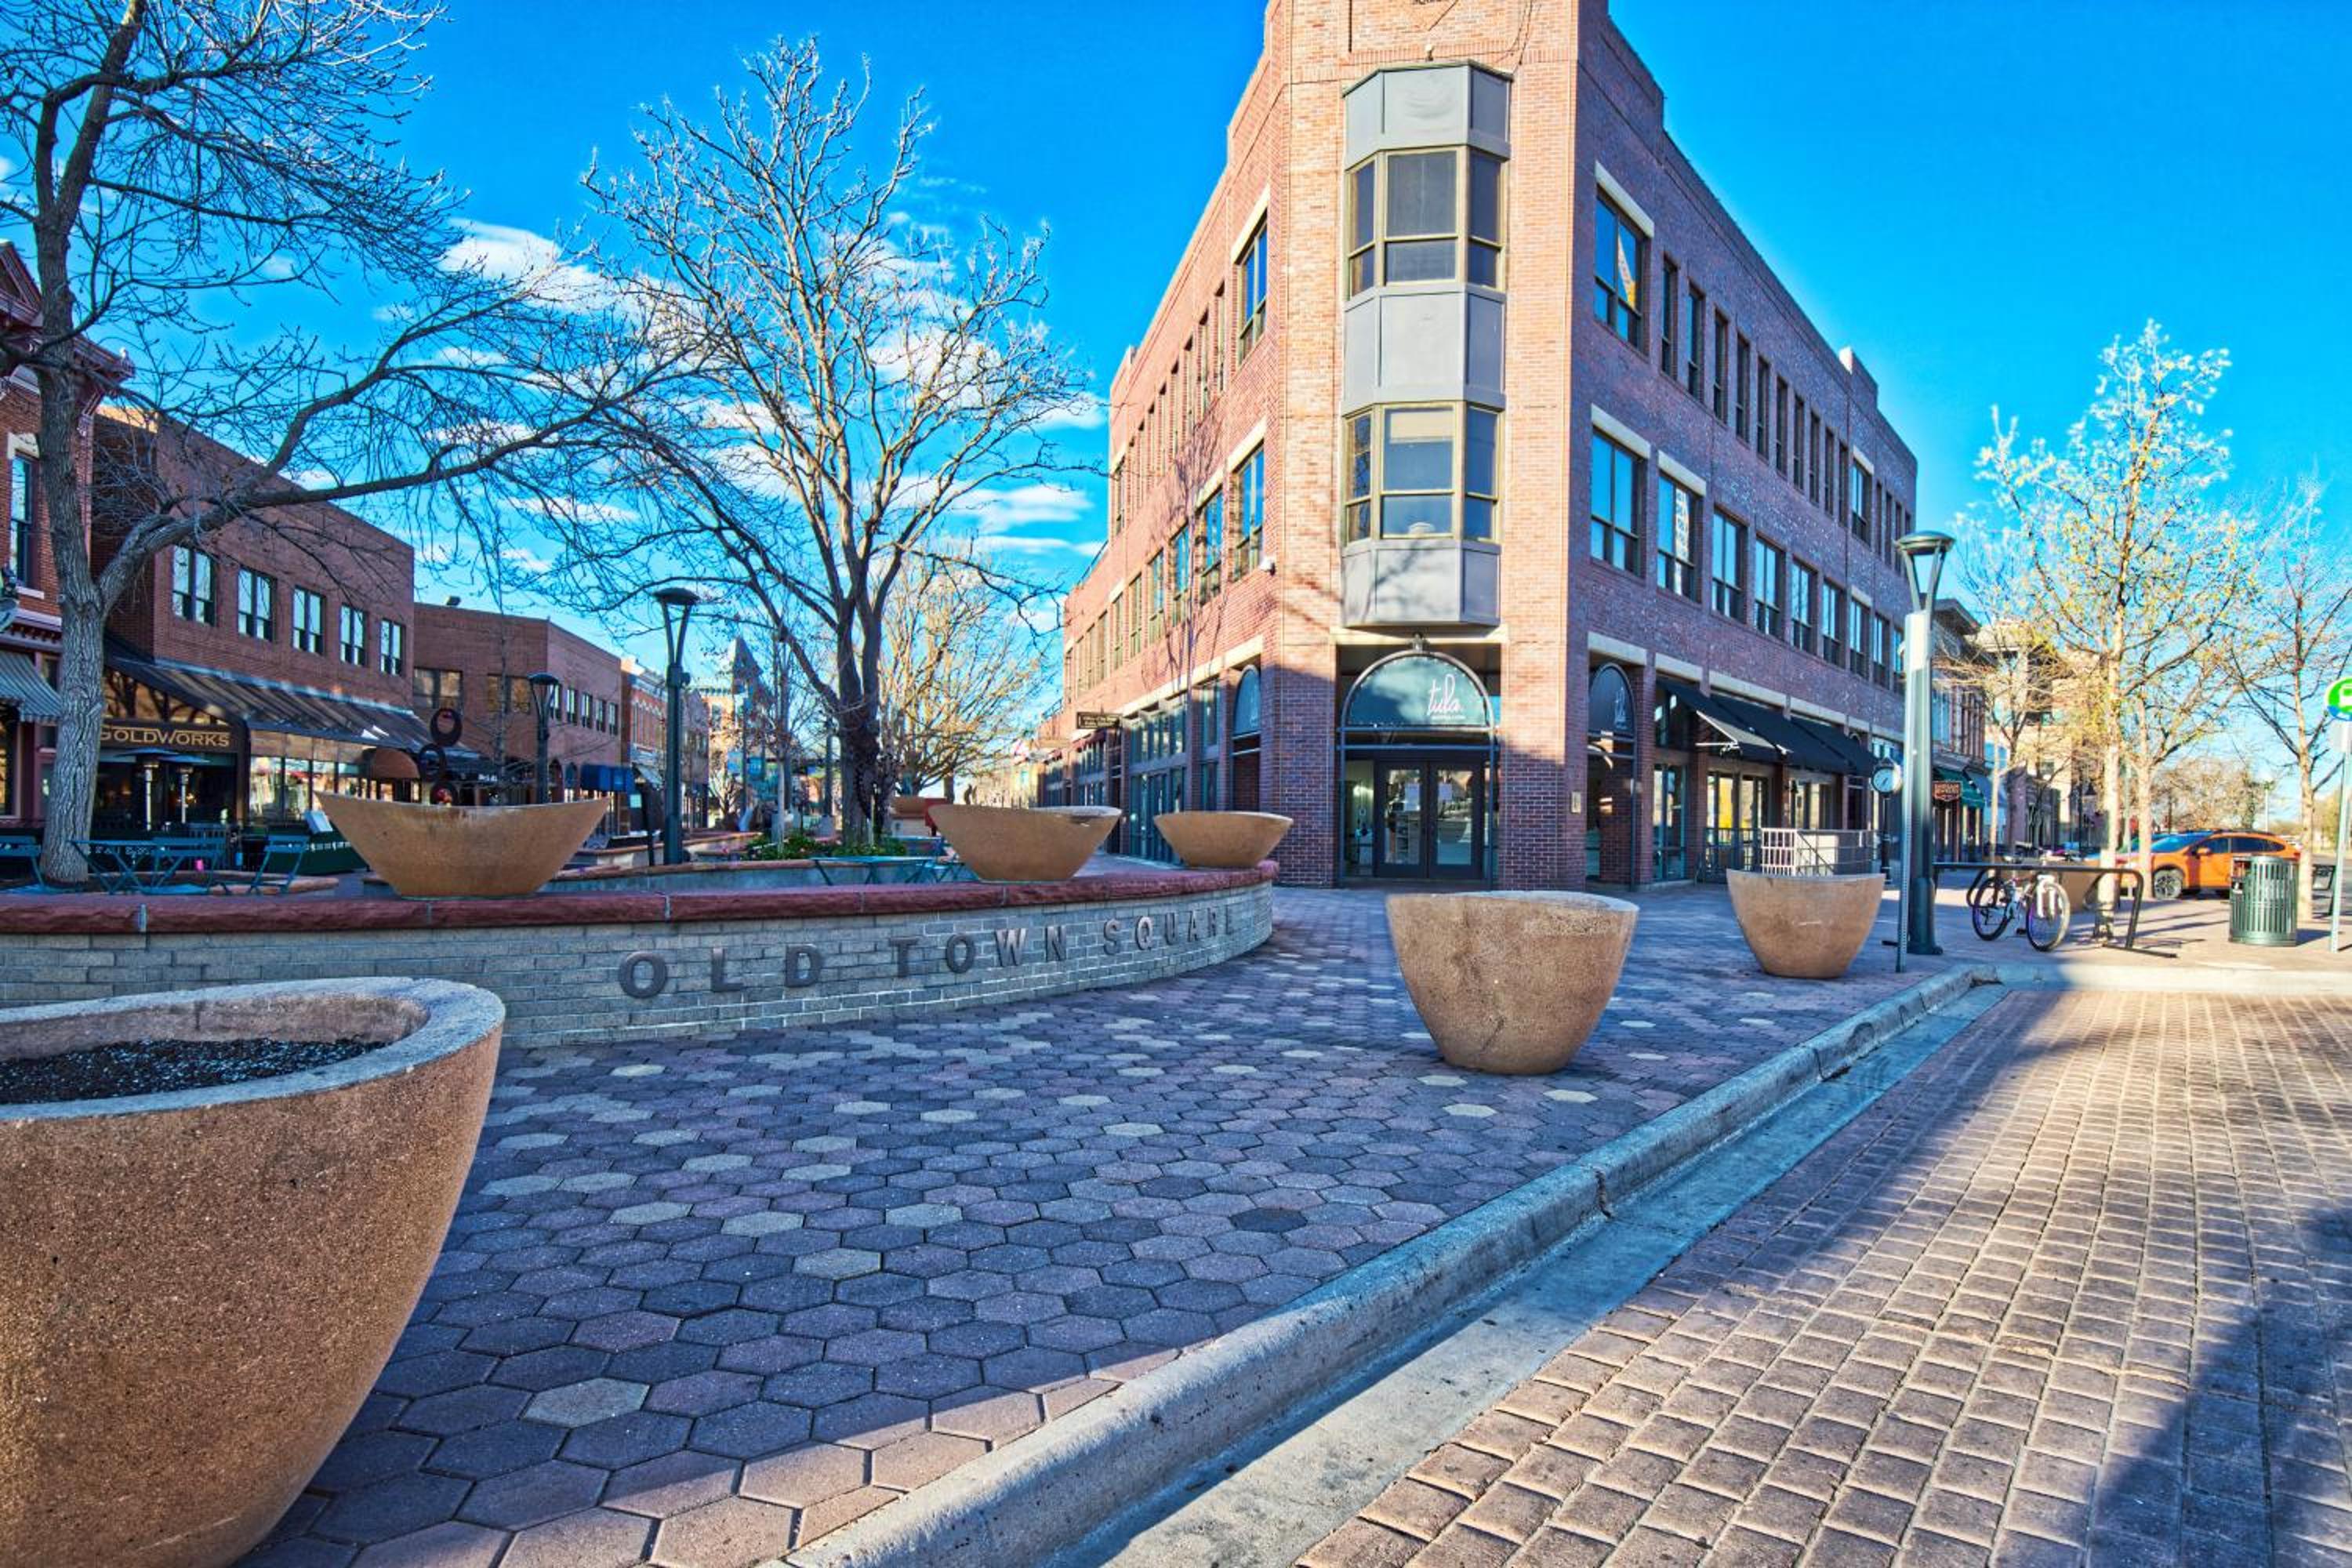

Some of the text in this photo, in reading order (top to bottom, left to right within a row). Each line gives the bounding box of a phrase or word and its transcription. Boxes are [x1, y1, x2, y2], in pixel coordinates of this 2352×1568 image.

[1427, 673, 1461, 716] tula
[100, 724, 230, 747] GOLDWORKS
[618, 903, 1234, 1000] OLD TOWN SQUARE
